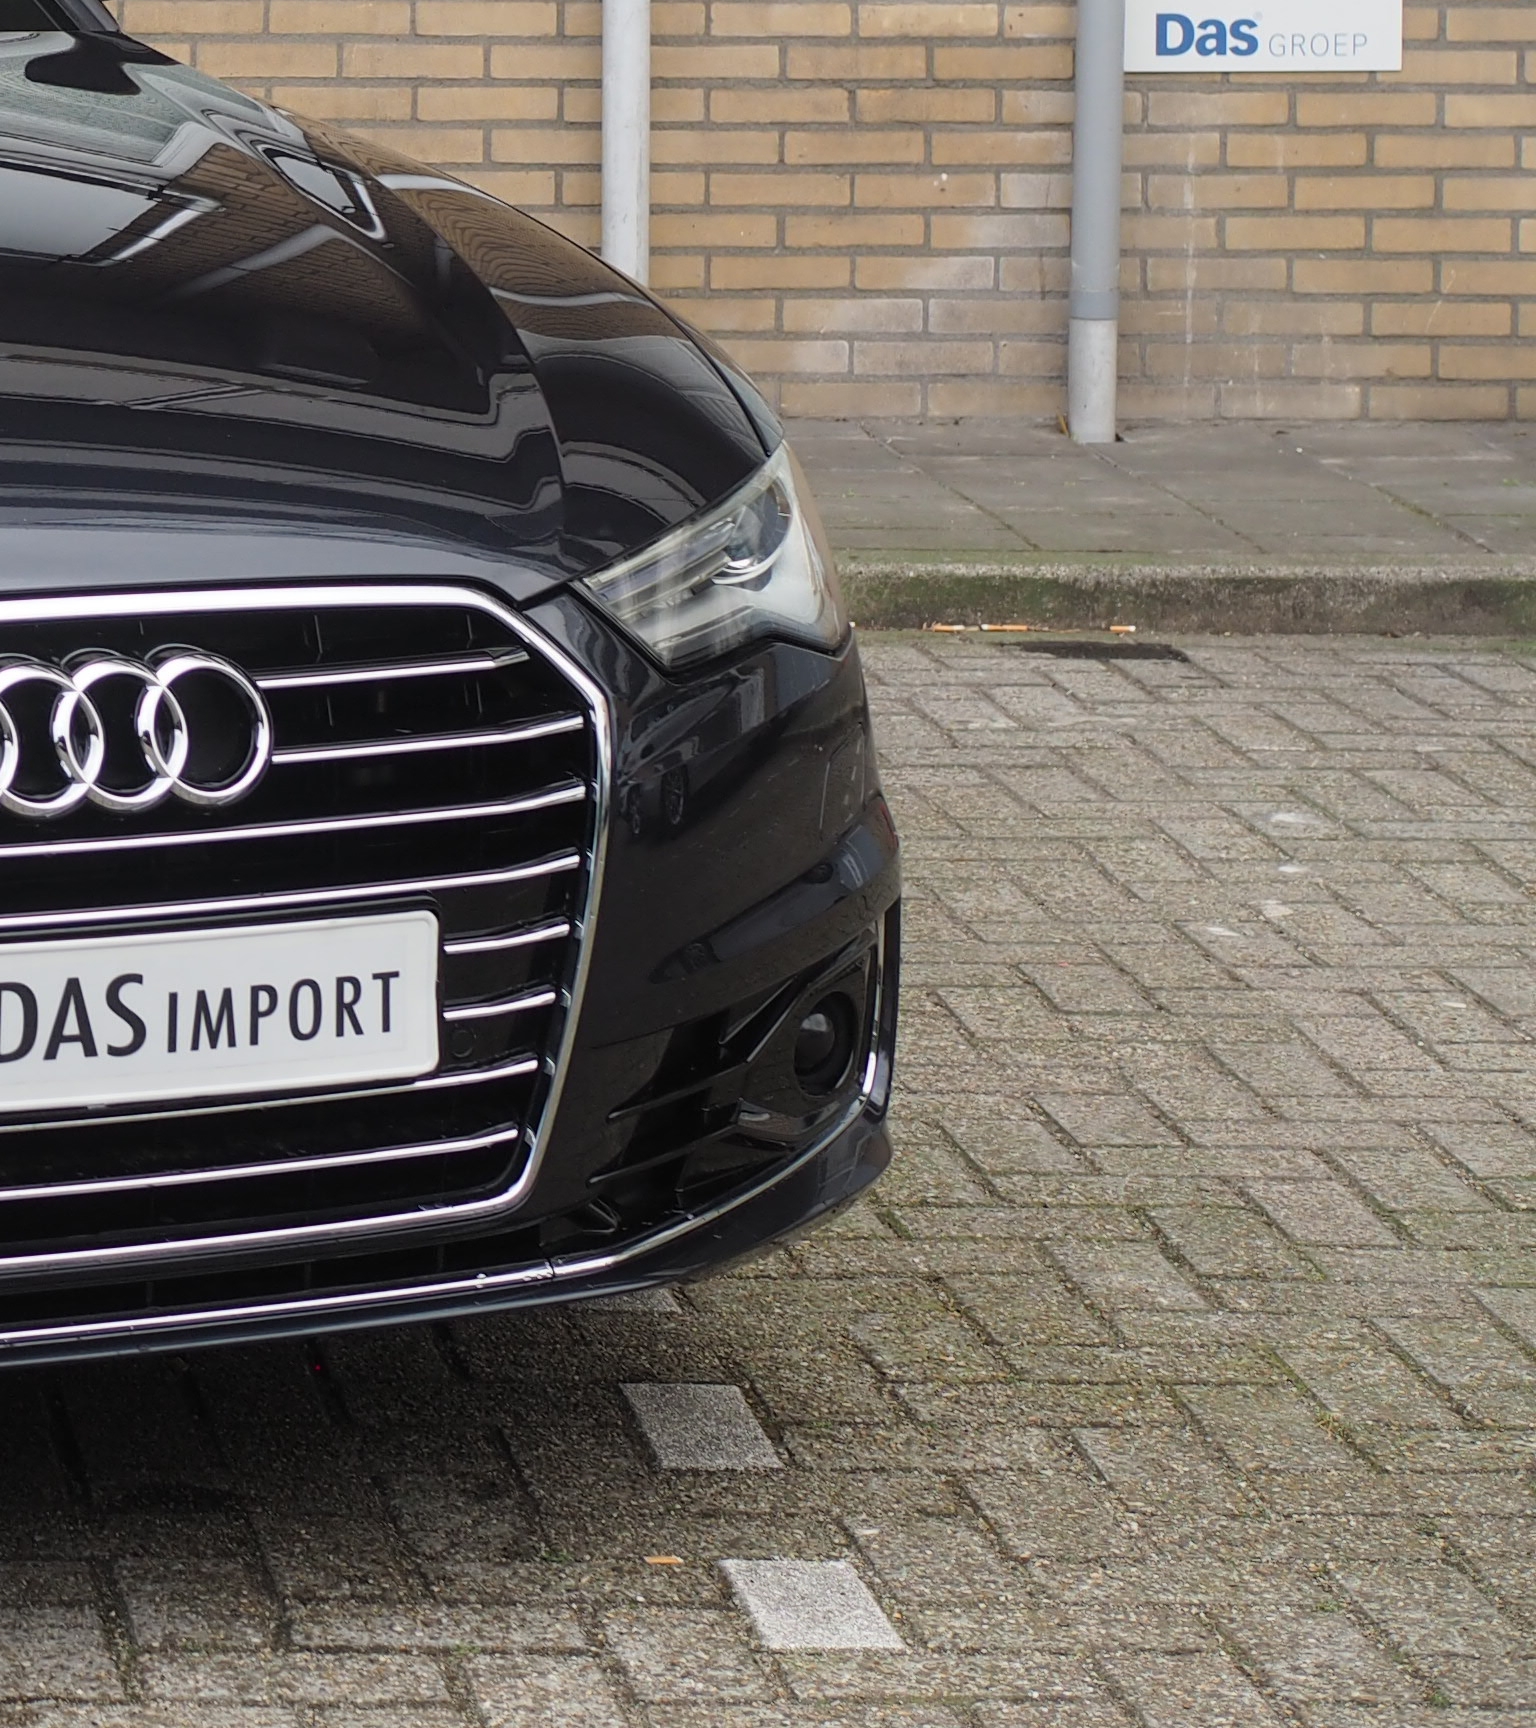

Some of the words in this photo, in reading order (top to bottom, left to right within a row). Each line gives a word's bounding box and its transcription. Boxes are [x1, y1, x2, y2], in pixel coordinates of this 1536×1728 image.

[1155, 13, 1260, 58] Das
[1268, 33, 1369, 58] GROEP
[166, 970, 401, 1055] IMPORT
